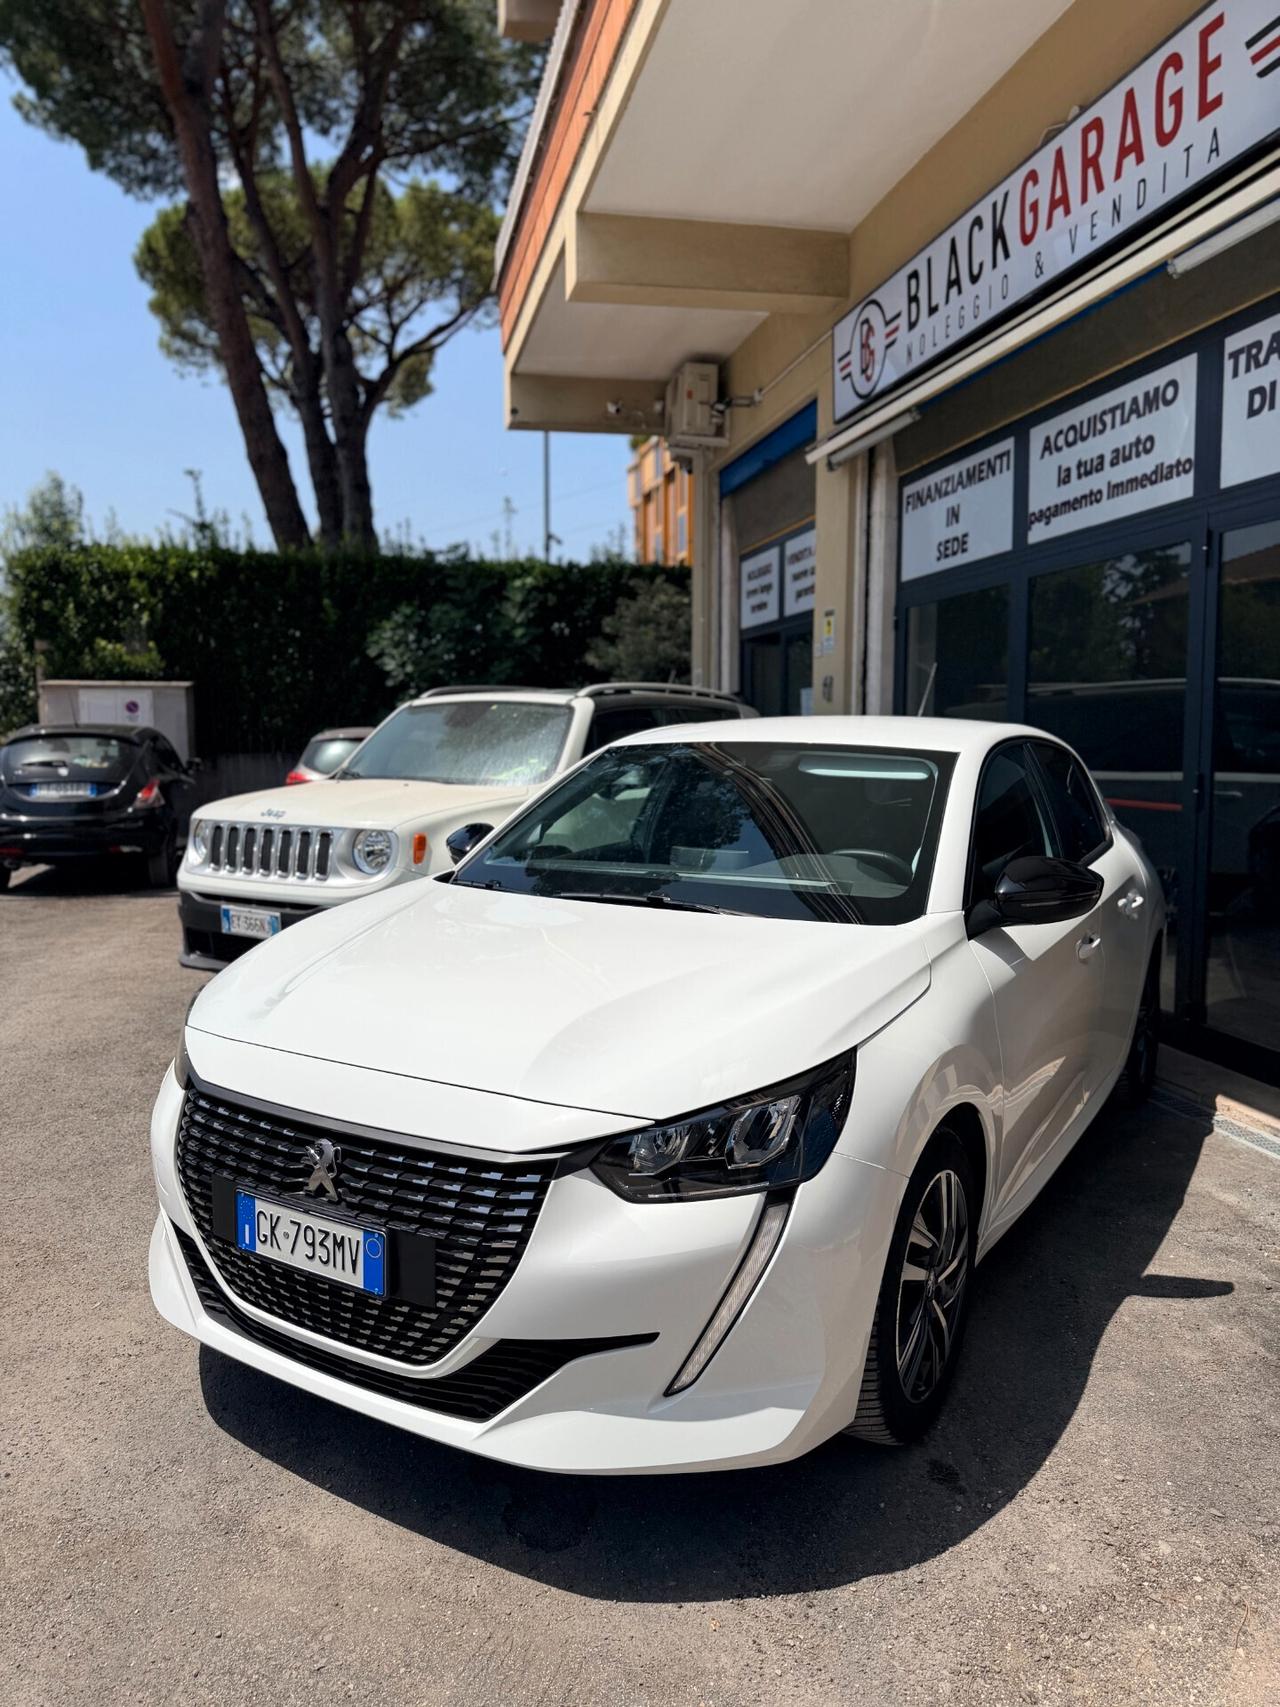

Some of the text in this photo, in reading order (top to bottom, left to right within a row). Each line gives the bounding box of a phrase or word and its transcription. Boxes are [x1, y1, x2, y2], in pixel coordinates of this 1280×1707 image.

[906, 127, 1220, 366] NOLEGGIO & VENDITA
[1040, 378, 1180, 460] ACQUISTIAMO
[1246, 380, 1277, 419] DI
[905, 448, 1011, 513] FINANZIAMENTI
[1056, 434, 1155, 488] la tua auto
[945, 503, 960, 528] IN
[1028, 487, 1103, 531] pagamento
[936, 533, 969, 562] SEDE
